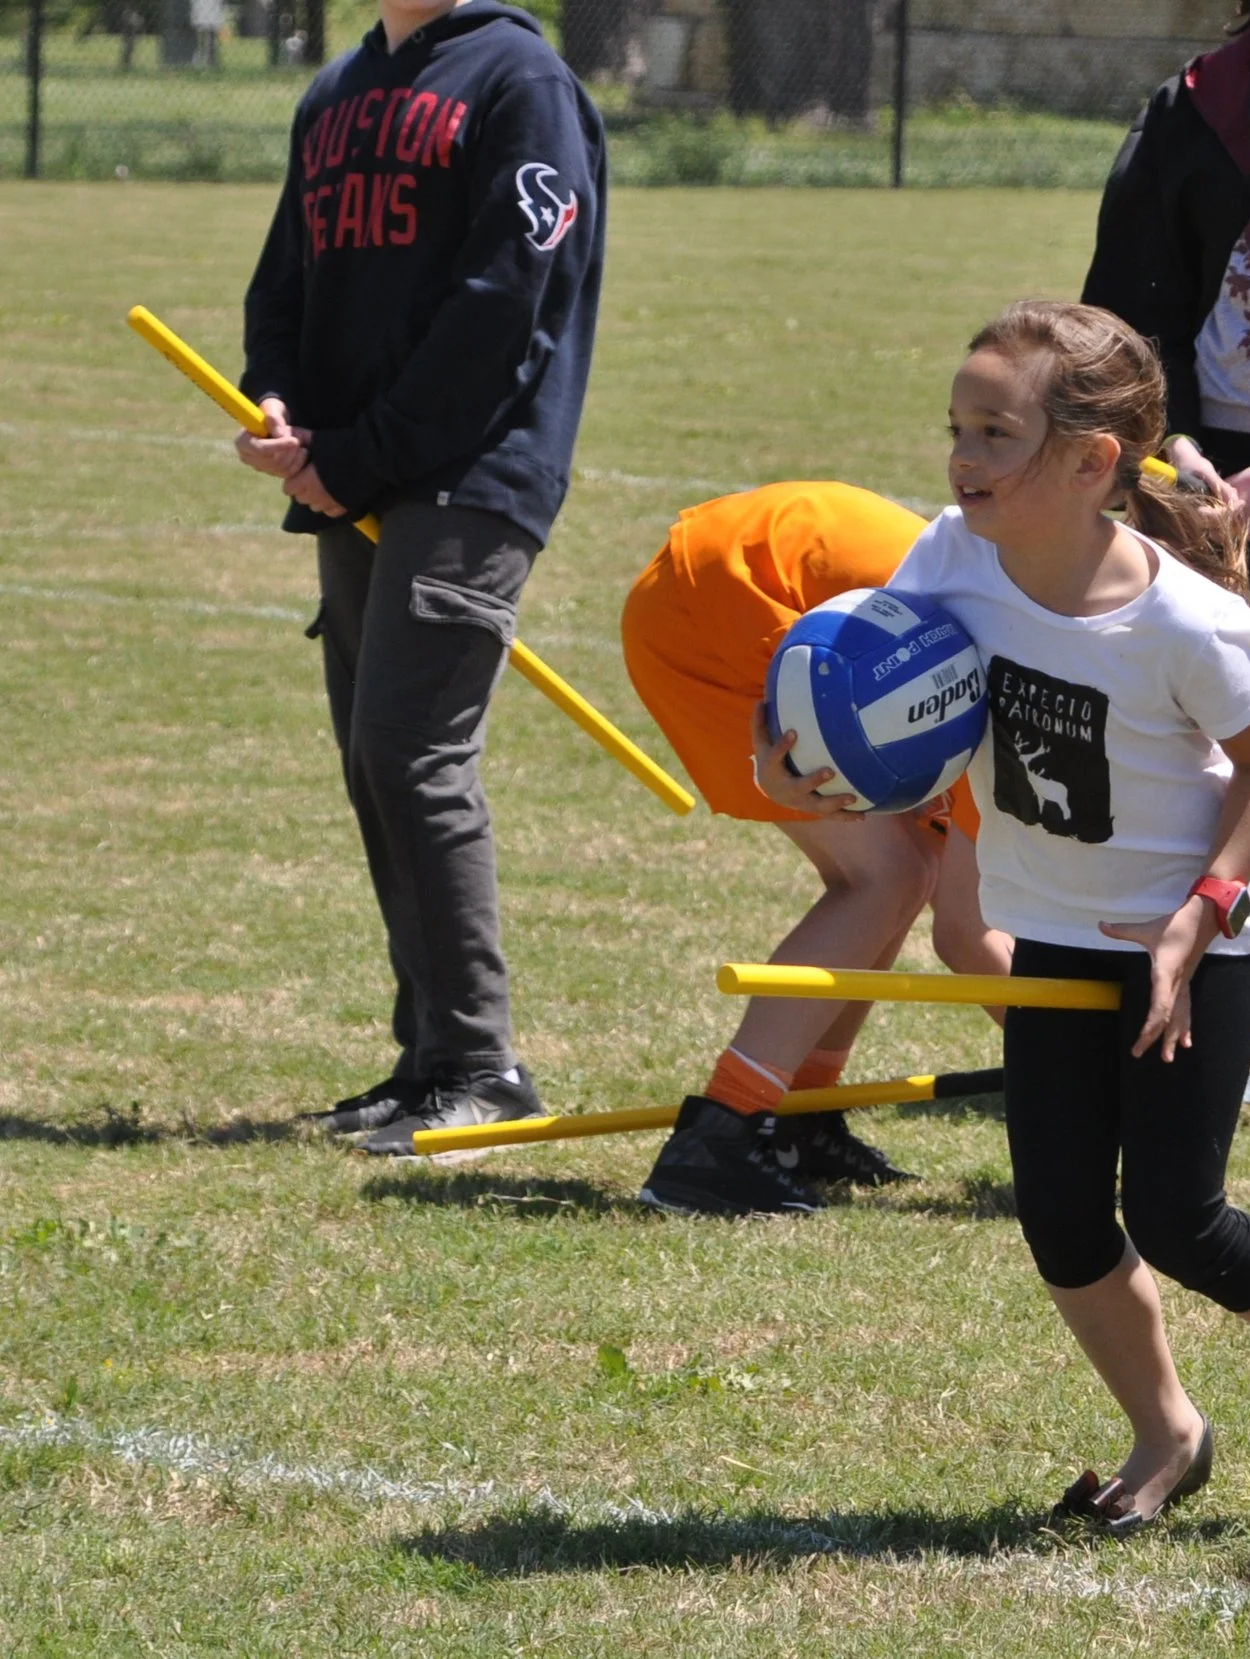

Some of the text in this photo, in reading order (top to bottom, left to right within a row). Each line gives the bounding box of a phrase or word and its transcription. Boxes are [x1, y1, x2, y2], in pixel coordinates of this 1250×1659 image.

[302, 87, 467, 181] OUSTON
[872, 640, 922, 681] POINT
[907, 667, 981, 724] Baden
[998, 696, 1092, 743] PATRONUM
[1002, 671, 1092, 721] EXPECTO
